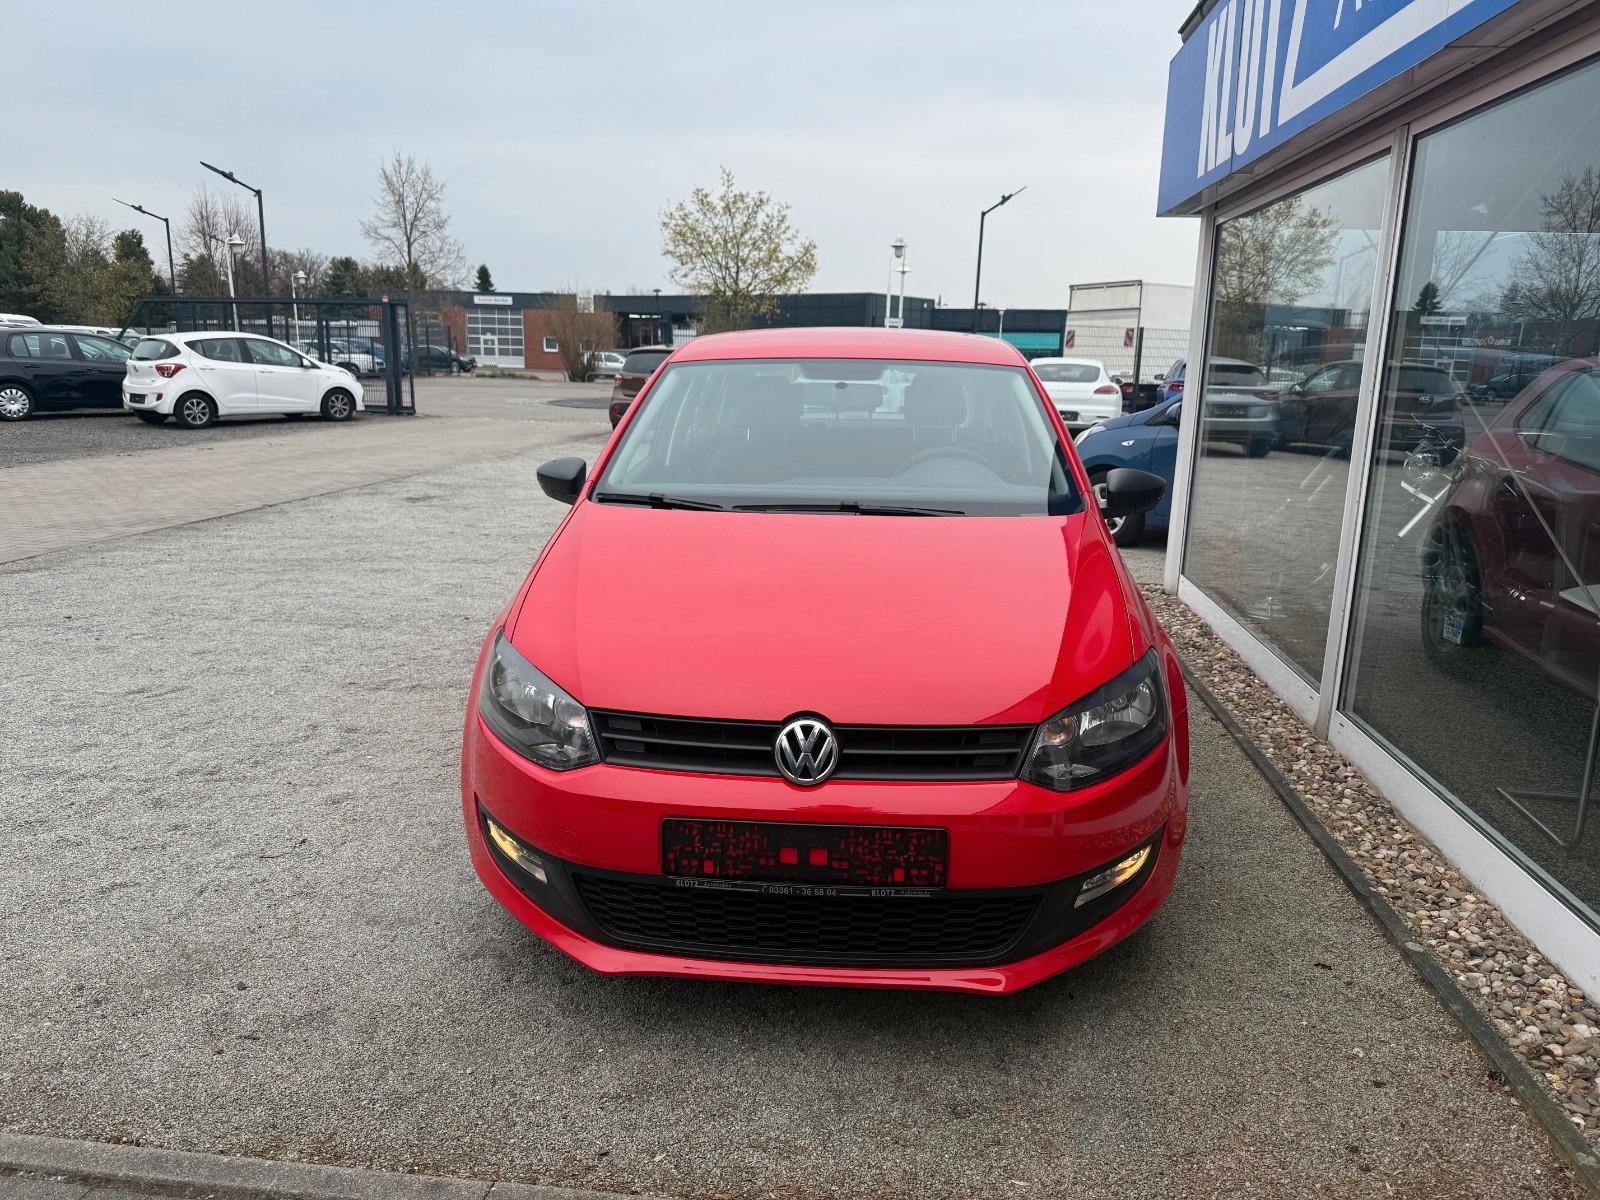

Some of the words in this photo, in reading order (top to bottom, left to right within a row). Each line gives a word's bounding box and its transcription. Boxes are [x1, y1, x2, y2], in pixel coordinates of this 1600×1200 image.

[777, 720, 837, 784] VW
[676, 879, 698, 888] KLOTZ
[769, 886, 793, 895] 03361
[801, 887, 812, 896] 36
[826, 888, 837, 897] 04
[871, 889, 896, 897] KLOTZ
